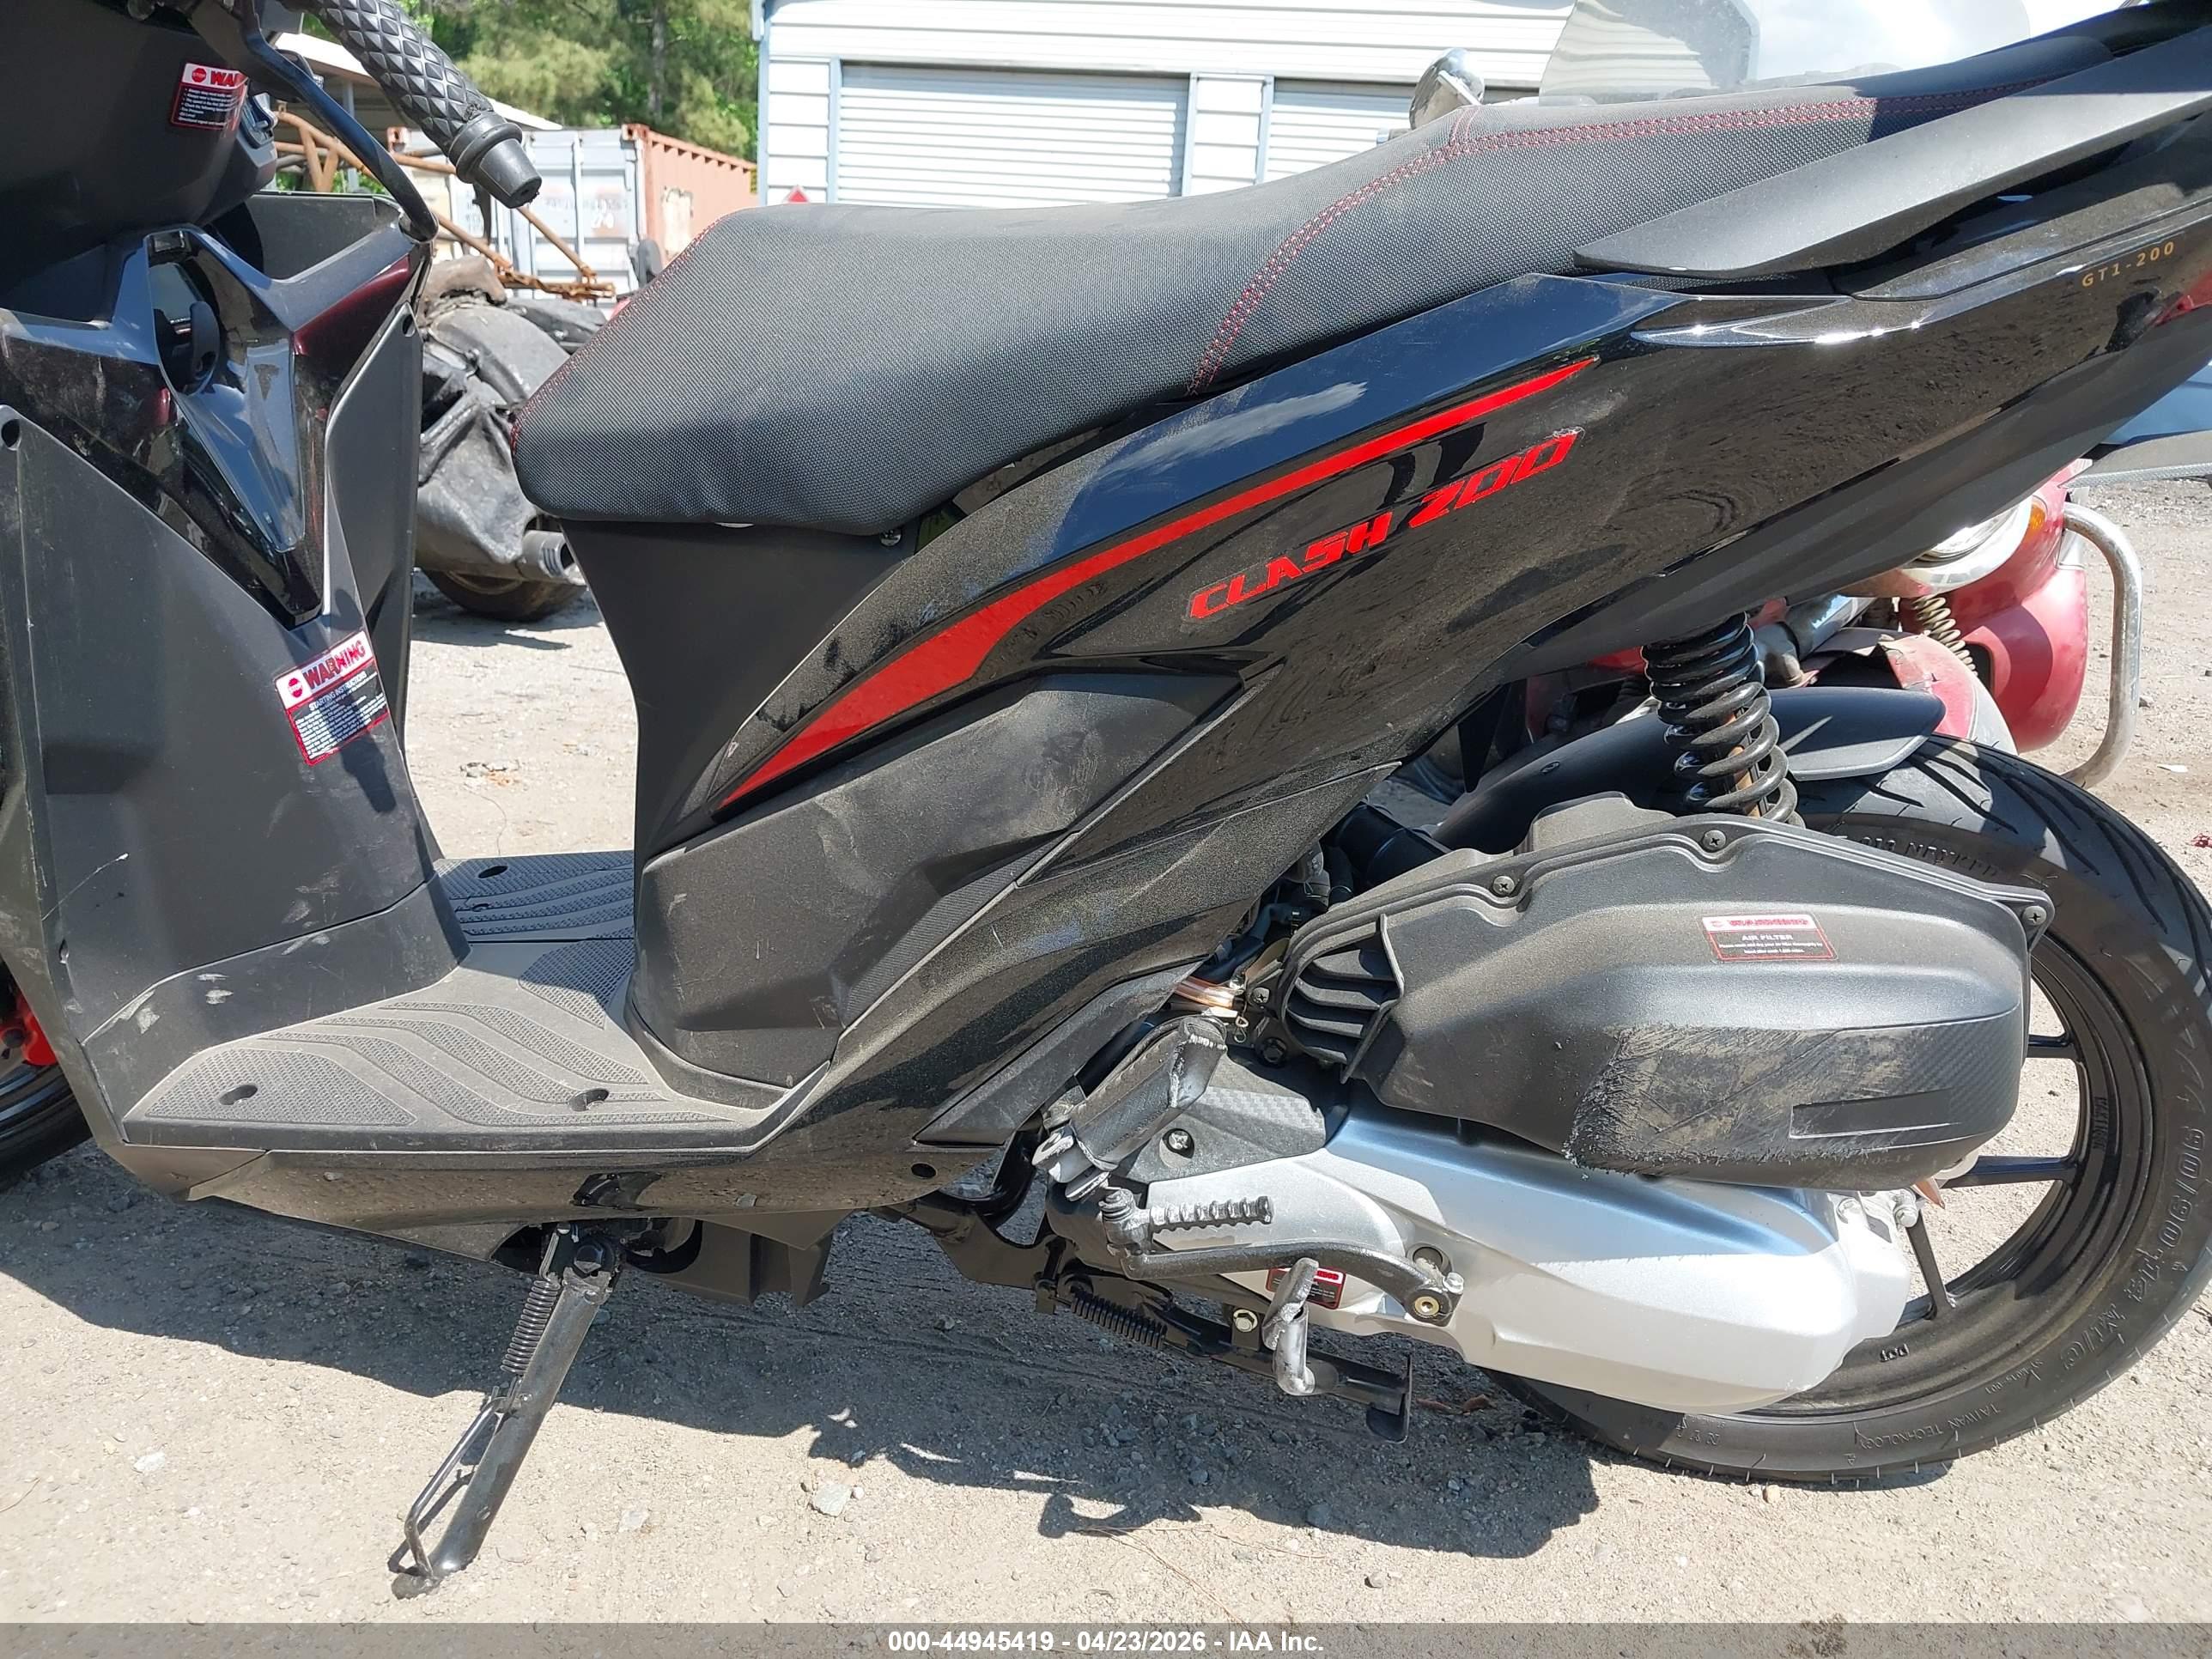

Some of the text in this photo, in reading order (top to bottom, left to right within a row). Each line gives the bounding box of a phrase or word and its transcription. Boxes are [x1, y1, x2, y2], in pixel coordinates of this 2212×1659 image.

[2081, 241, 2174, 287] GT1-200
[1189, 429, 1579, 618] CLASH 200
[302, 640, 367, 690] WARNING
